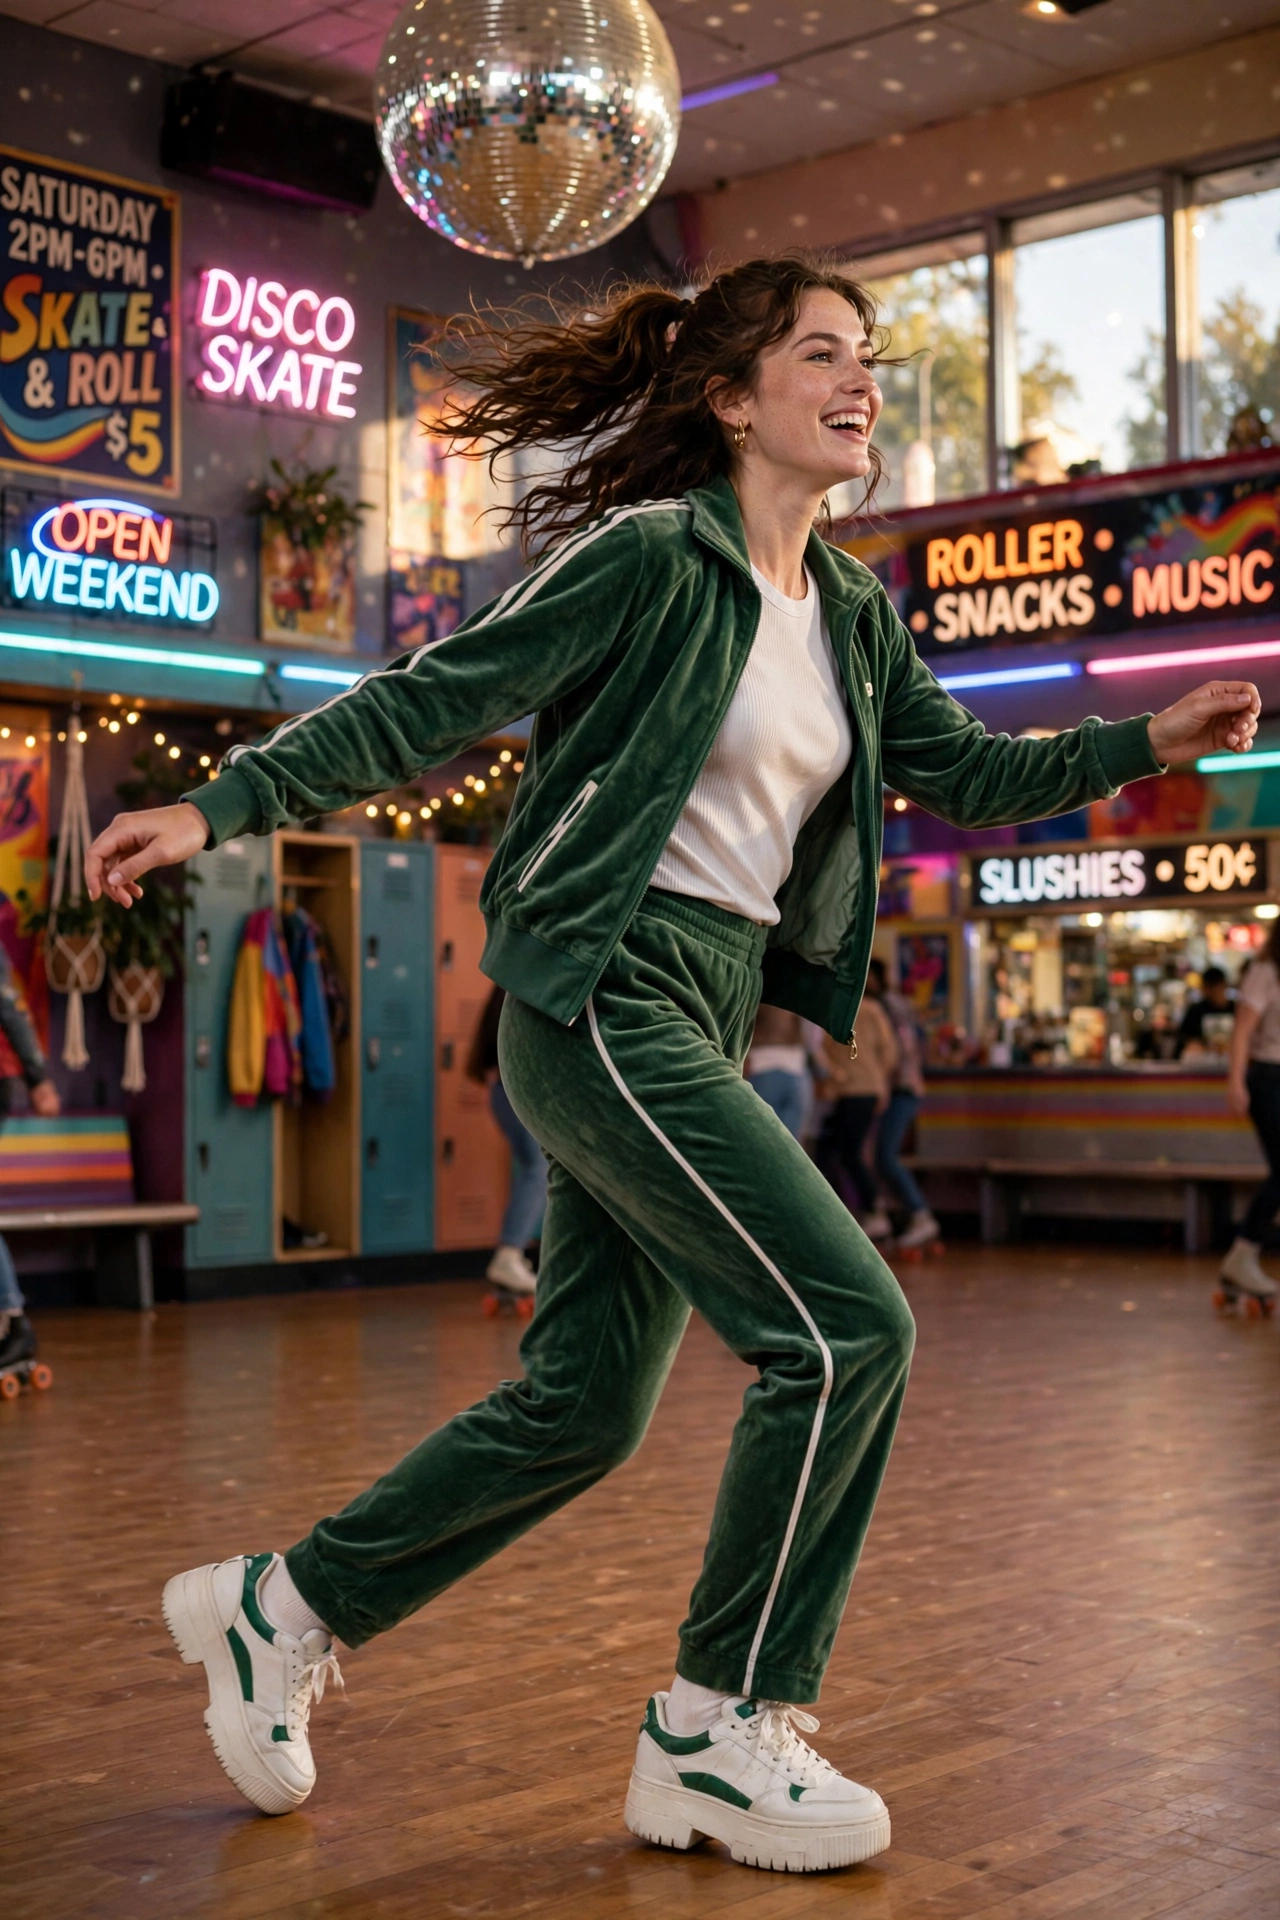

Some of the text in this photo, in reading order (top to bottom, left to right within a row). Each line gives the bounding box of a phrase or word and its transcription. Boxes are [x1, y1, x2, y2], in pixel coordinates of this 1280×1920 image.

[1, 166, 157, 243] SATURDAY
[8, 218, 147, 287] 2PM-6PM
[0, 273, 153, 363] SKATE
[202, 268, 356, 352] DISCO
[23, 350, 162, 409] & ROLL
[202, 335, 362, 419] SKATE
[105, 408, 163, 476] $5
[52, 502, 173, 564] OPEN
[927, 519, 1084, 589] ROLLER
[10, 547, 220, 622] WEEKEND
[933, 574, 1096, 643] SNACKS
[1132, 549, 1274, 618] MUSIC
[980, 842, 1257, 904] SLUSHIES 50¢
